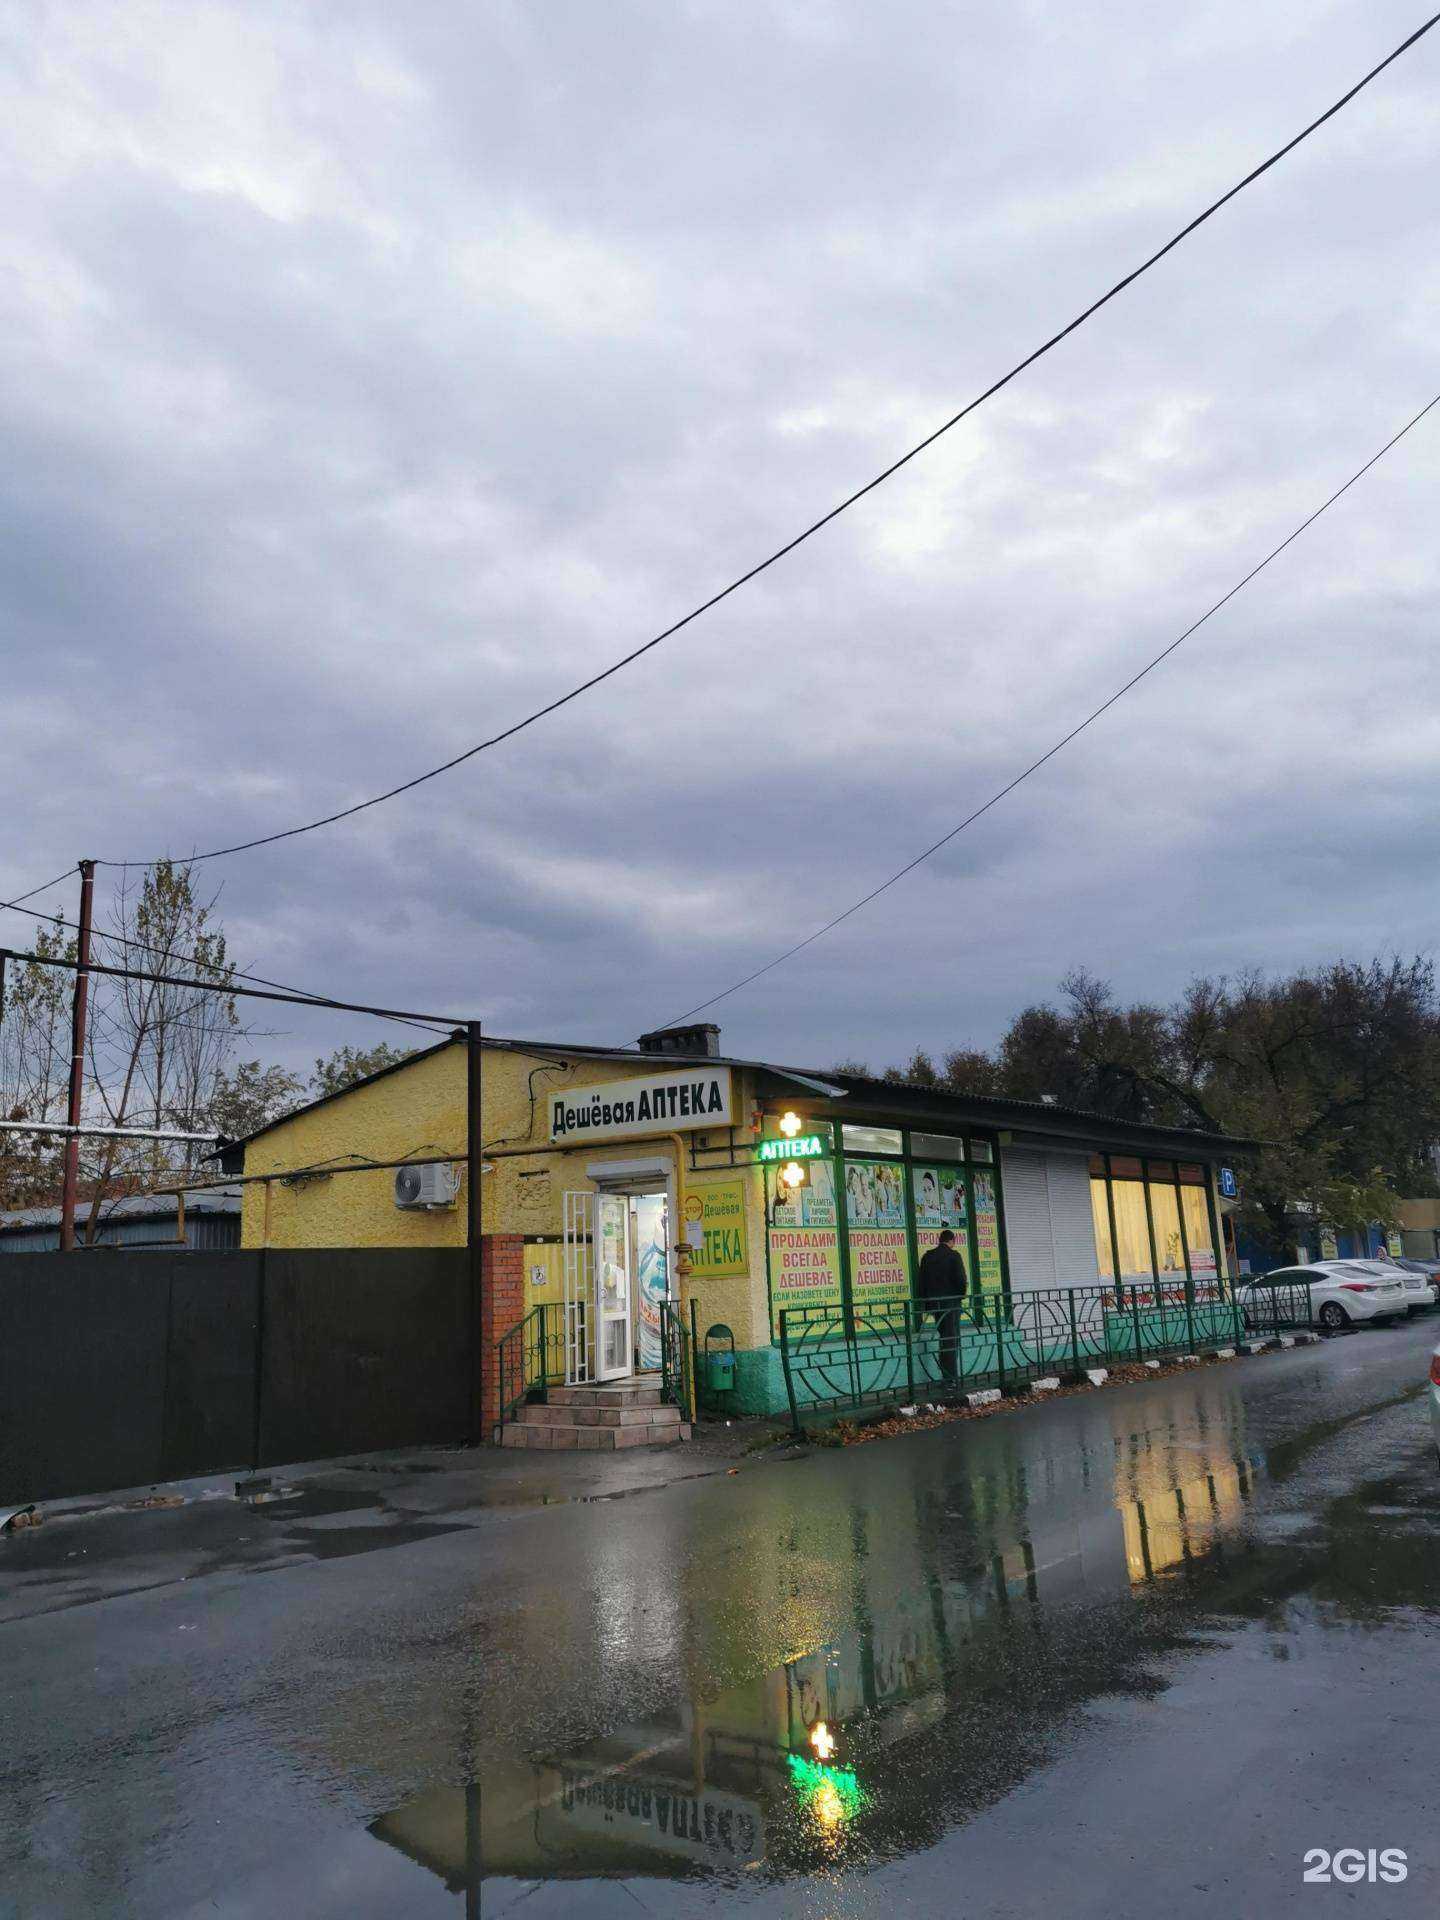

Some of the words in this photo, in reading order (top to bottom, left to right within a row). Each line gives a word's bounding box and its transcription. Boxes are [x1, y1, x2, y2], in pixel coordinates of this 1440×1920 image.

[553, 1095, 634, 1135] Дешёвая
[637, 1080, 723, 1121] АПТЕКА
[760, 1136, 821, 1159] АПТЕКА
[771, 1232, 836, 1249] ПРОДАДИМ
[849, 1231, 906, 1247] ПРОДАДИМ
[918, 1232, 967, 1246] ПРОИМ
[782, 1252, 828, 1268] ВСЕГДА
[859, 1250, 899, 1266] ВСЕГДА
[779, 1271, 834, 1288] ДЕШЕВЛЕ
[857, 1269, 905, 1285] ДЕШЕВЛЕ
